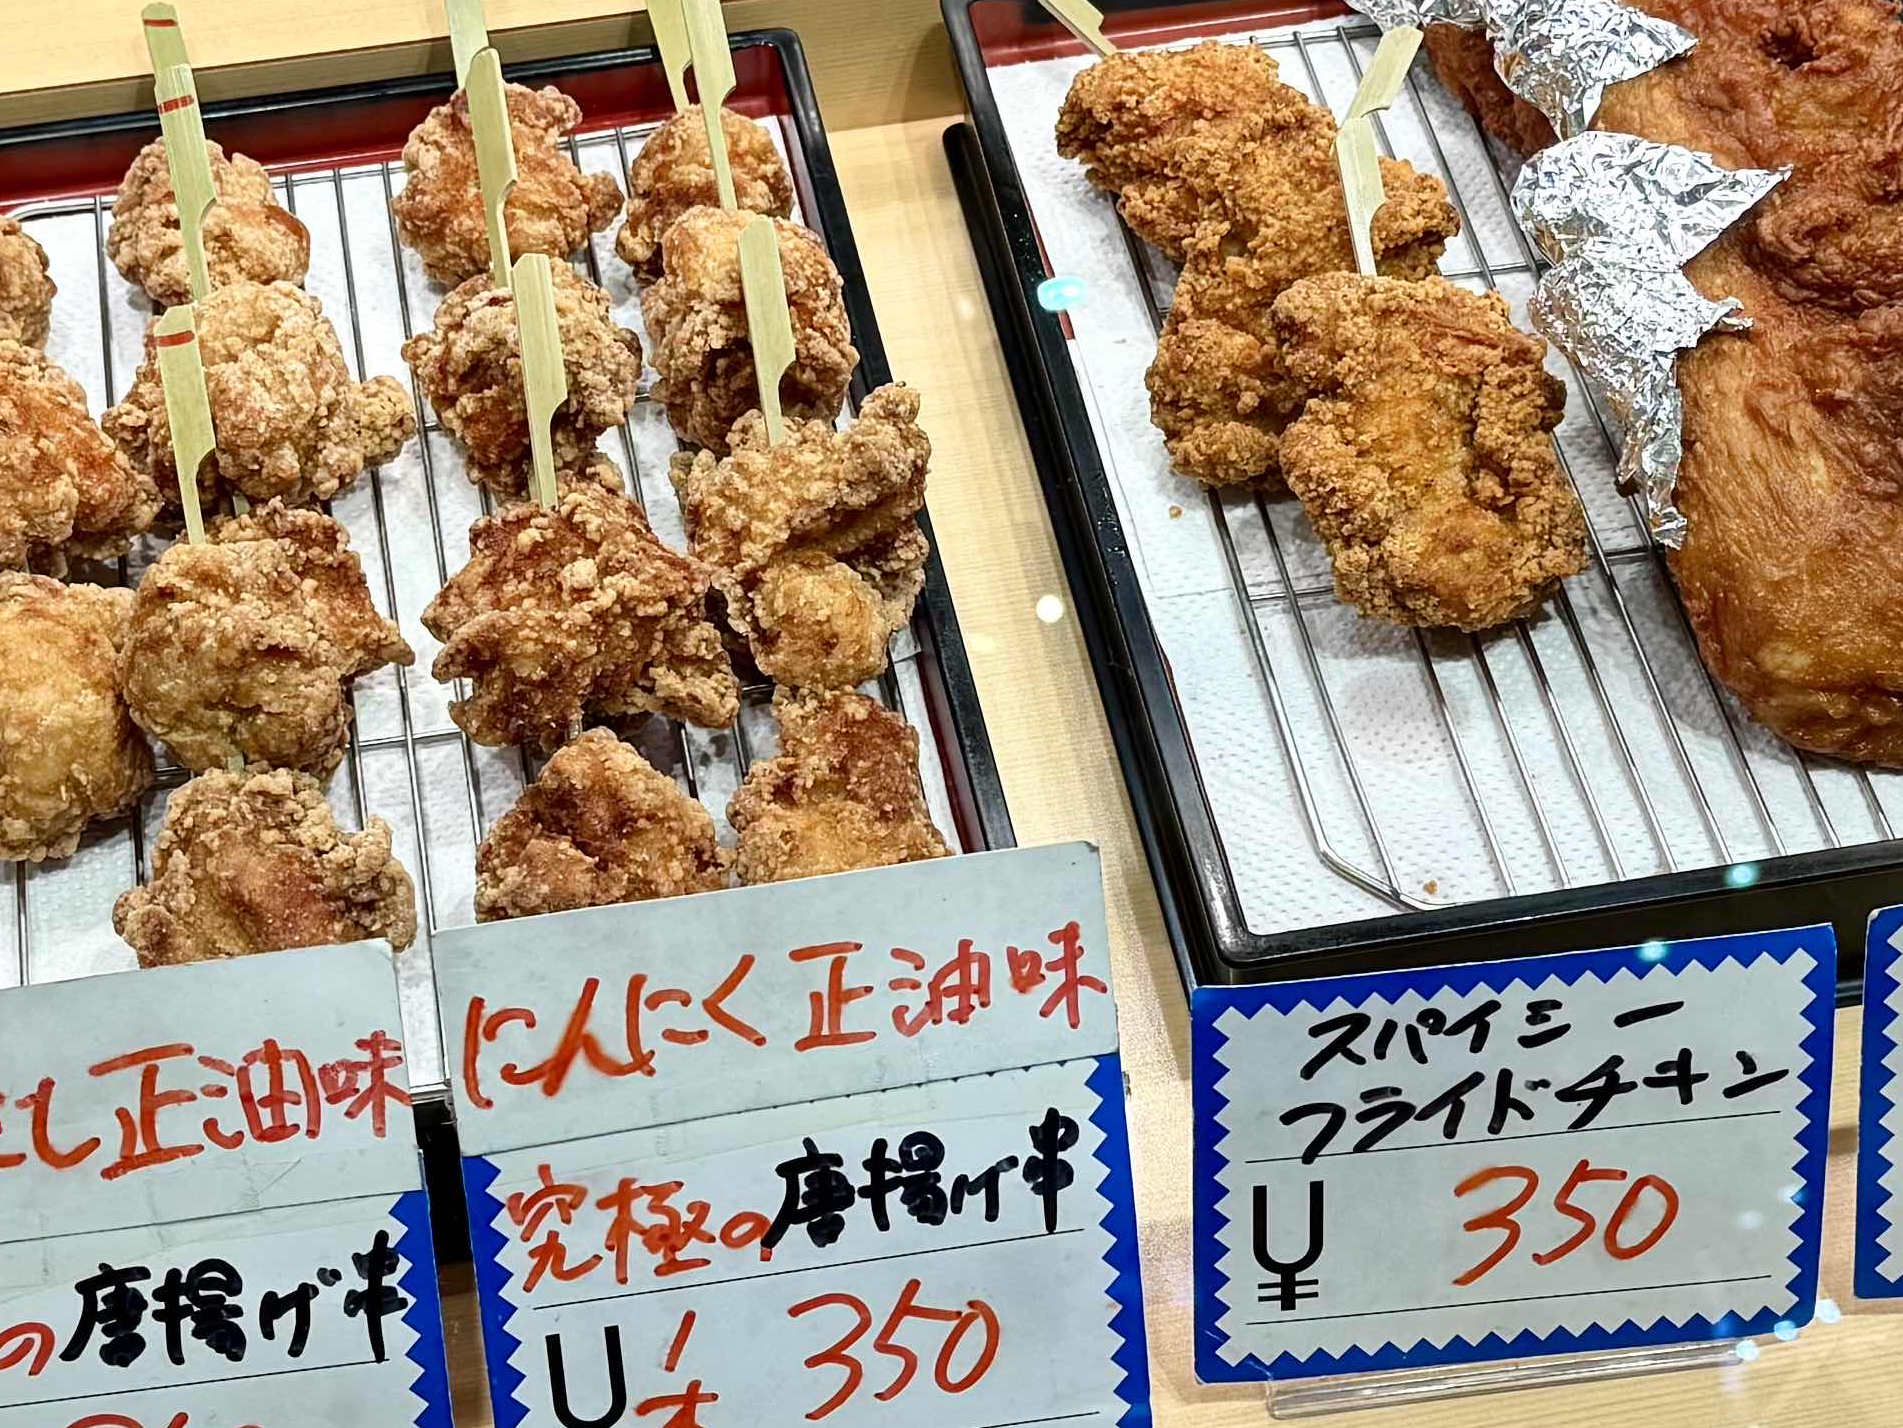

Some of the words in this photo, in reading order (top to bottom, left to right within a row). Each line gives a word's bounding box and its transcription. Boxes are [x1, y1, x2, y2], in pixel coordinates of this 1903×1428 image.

[463, 921, 1108, 1109] にんにく正油味
[1299, 999, 1685, 1080] スパイシー
[1279, 1049, 1790, 1165] フライドチキン
[1452, 1158, 1680, 1287] 350
[787, 1278, 1000, 1421] 350
